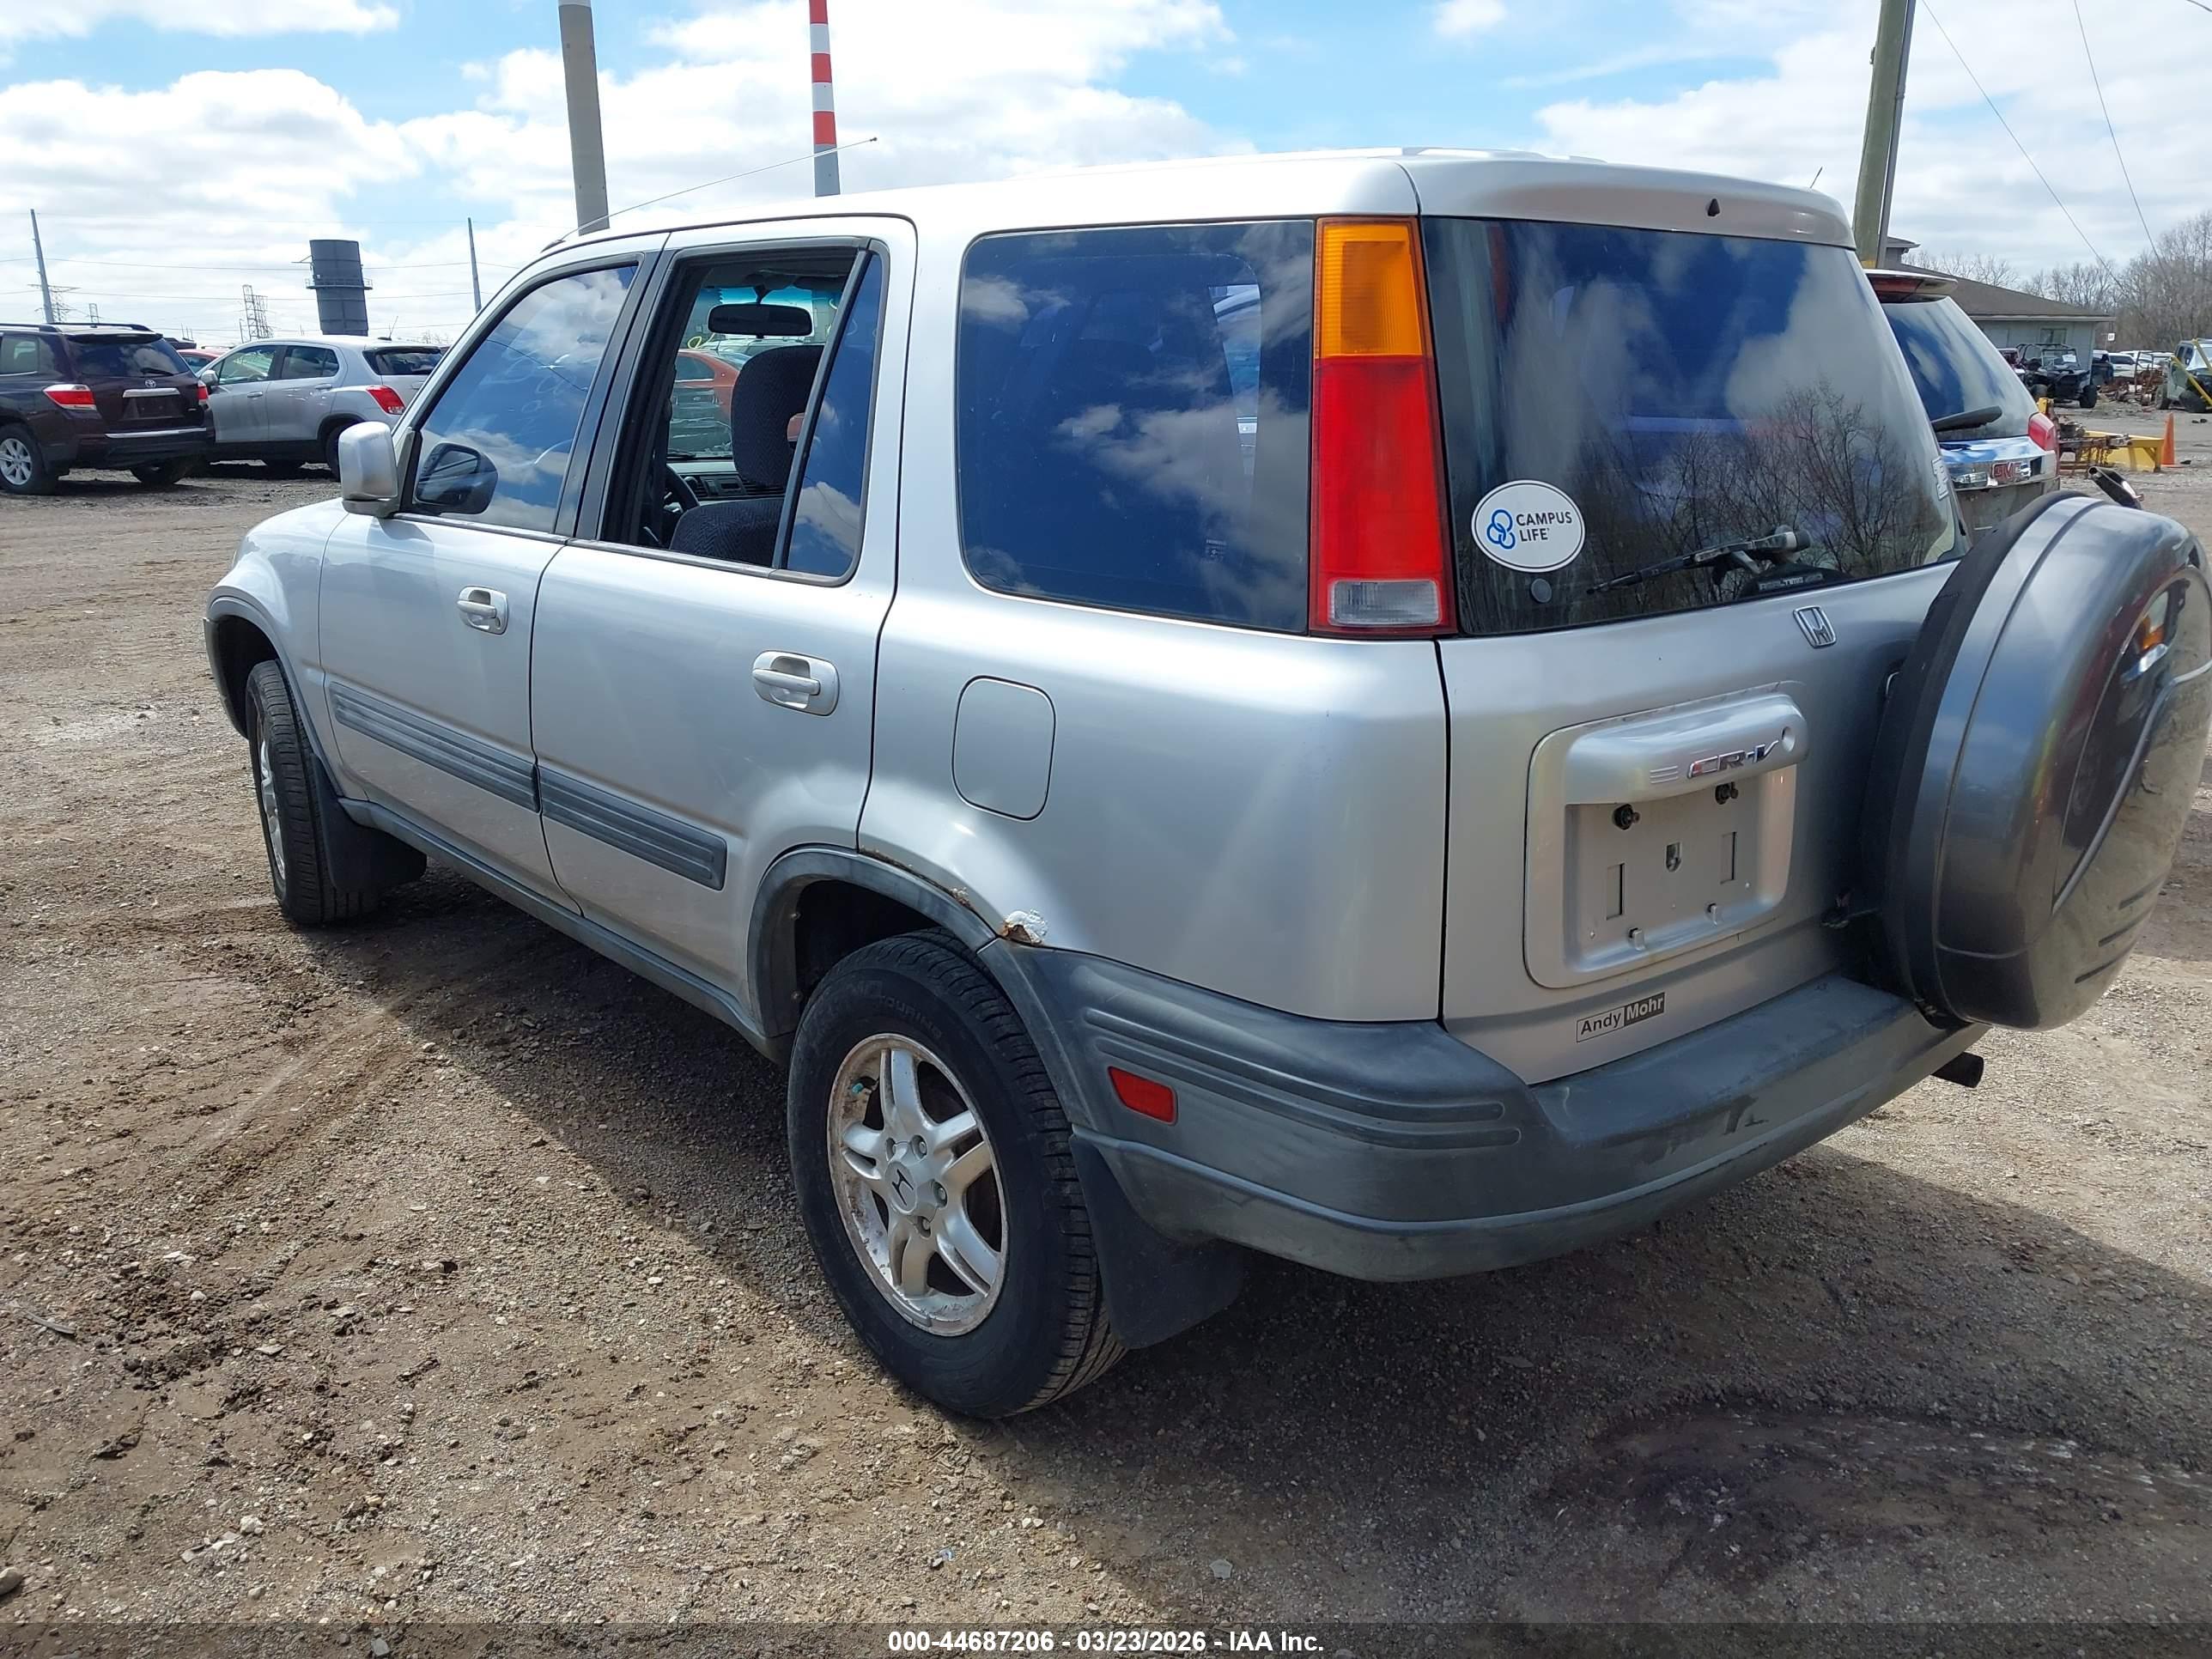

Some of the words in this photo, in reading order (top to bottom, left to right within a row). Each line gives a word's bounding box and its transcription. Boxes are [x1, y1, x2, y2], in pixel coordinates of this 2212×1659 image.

[1516, 512, 1573, 526] CAMPUS
[1519, 528, 1549, 542] LIFE
[1687, 740, 1779, 778] CR-V
[1581, 1012, 1622, 1036] Andy
[1626, 997, 1664, 1022] Mohr
